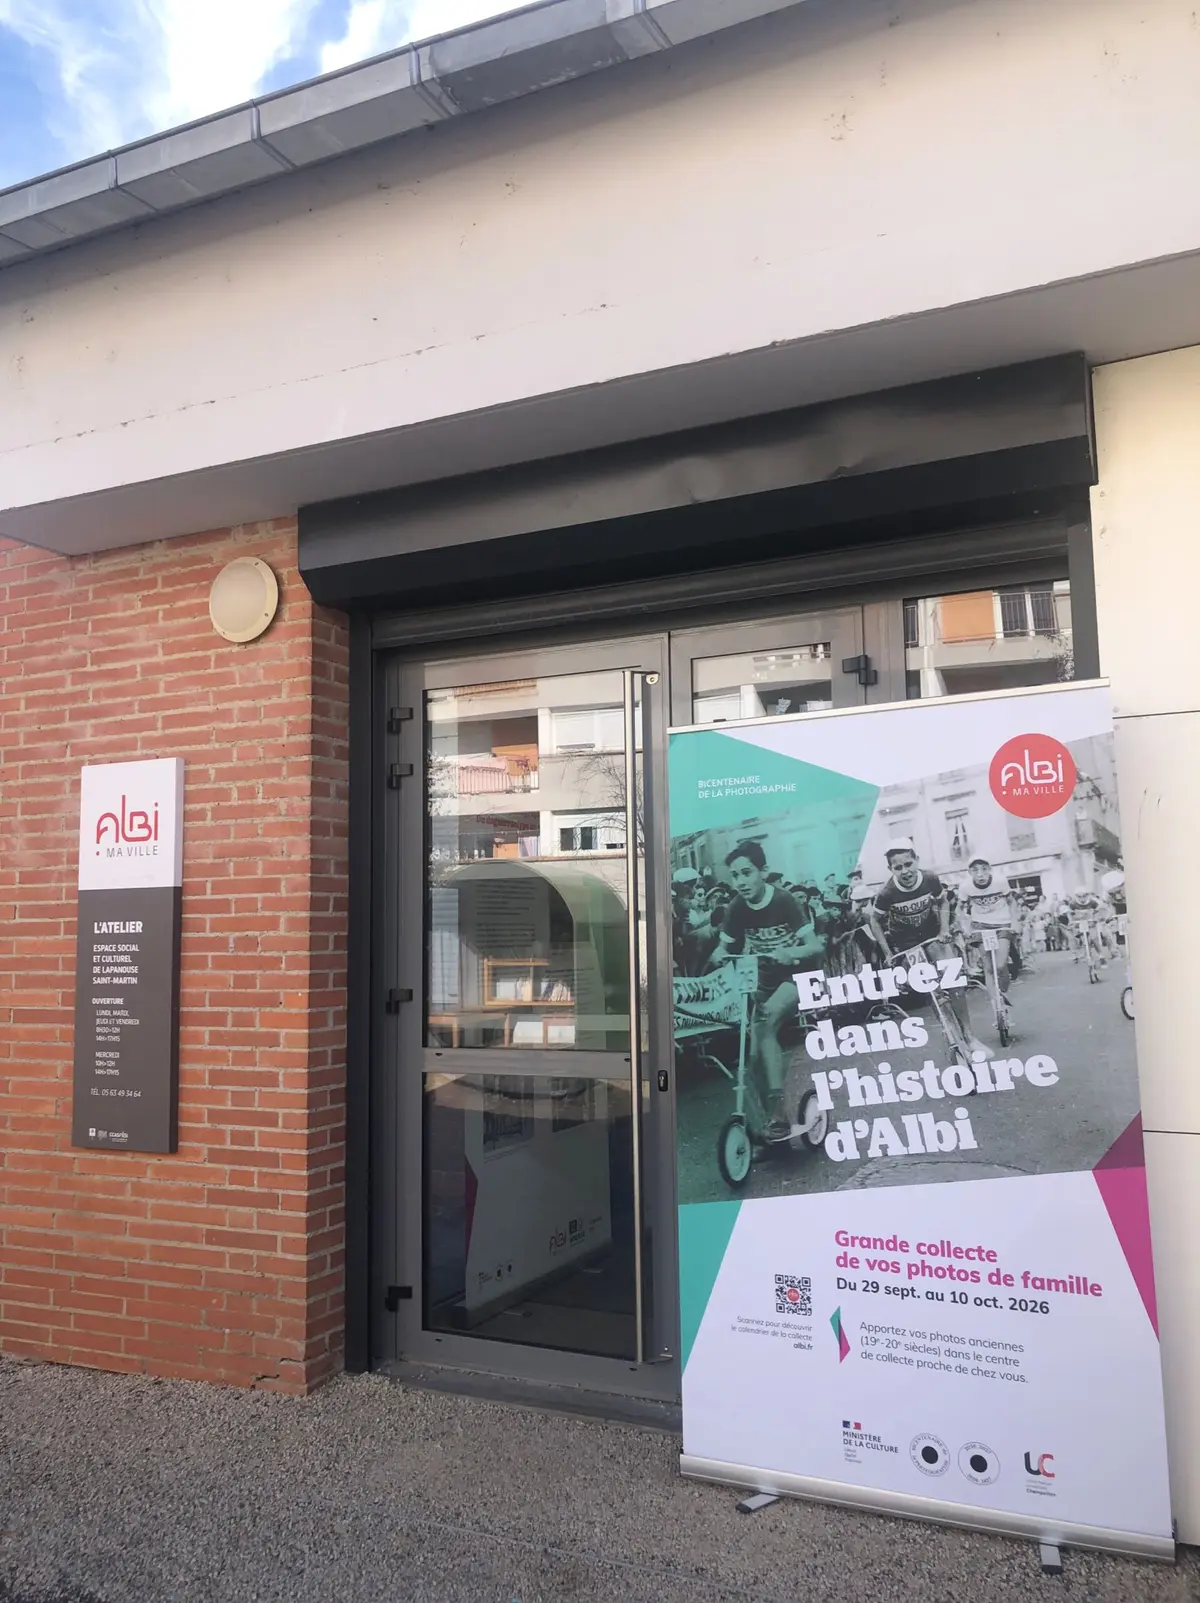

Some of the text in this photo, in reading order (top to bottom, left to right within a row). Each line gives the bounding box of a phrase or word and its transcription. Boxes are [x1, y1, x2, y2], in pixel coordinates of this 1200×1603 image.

[698, 775, 760, 788] BICENTENAIRE
[698, 782, 797, 799] DE LA PHOTOGRAPHIE
[1012, 784, 1065, 797] MA VILLE
[106, 845, 158, 858] MA VILLE
[93, 920, 143, 934] L'ATELIER
[93, 943, 140, 952] ESPACE SOCIAL
[93, 954, 132, 963] ET CULTUREL
[92, 965, 139, 974] DE LAPANOUSE
[92, 976, 138, 985] SAINT-MARTIN
[792, 957, 968, 1010] Entrez
[805, 1016, 929, 1060] dans
[811, 1050, 1060, 1111] l'histoire
[824, 1107, 978, 1162] d'Albi
[835, 1230, 998, 1263] Grande collecte
[835, 1251, 1103, 1297] de vos photos de famille
[836, 1277, 1050, 1315] Du 29 sept. au 10 oct. 2026
[737, 1315, 813, 1332] Scannez pour découvrir
[770, 1329, 780, 1337] de
[787, 1332, 813, 1341] collecte
[860, 1321, 1025, 1353] Apportez vos photos anciennes
[903, 1341, 941, 1357] siècles)
[943, 1347, 971, 1361] dans
[973, 1351, 983, 1362] le
[985, 1356, 1020, 1367] centre
[860, 1350, 1029, 1384] de collecte proche de chez vous.
[842, 1430, 882, 1443] MINISTÈRE
[843, 1438, 899, 1454] DE LA CULTURE
